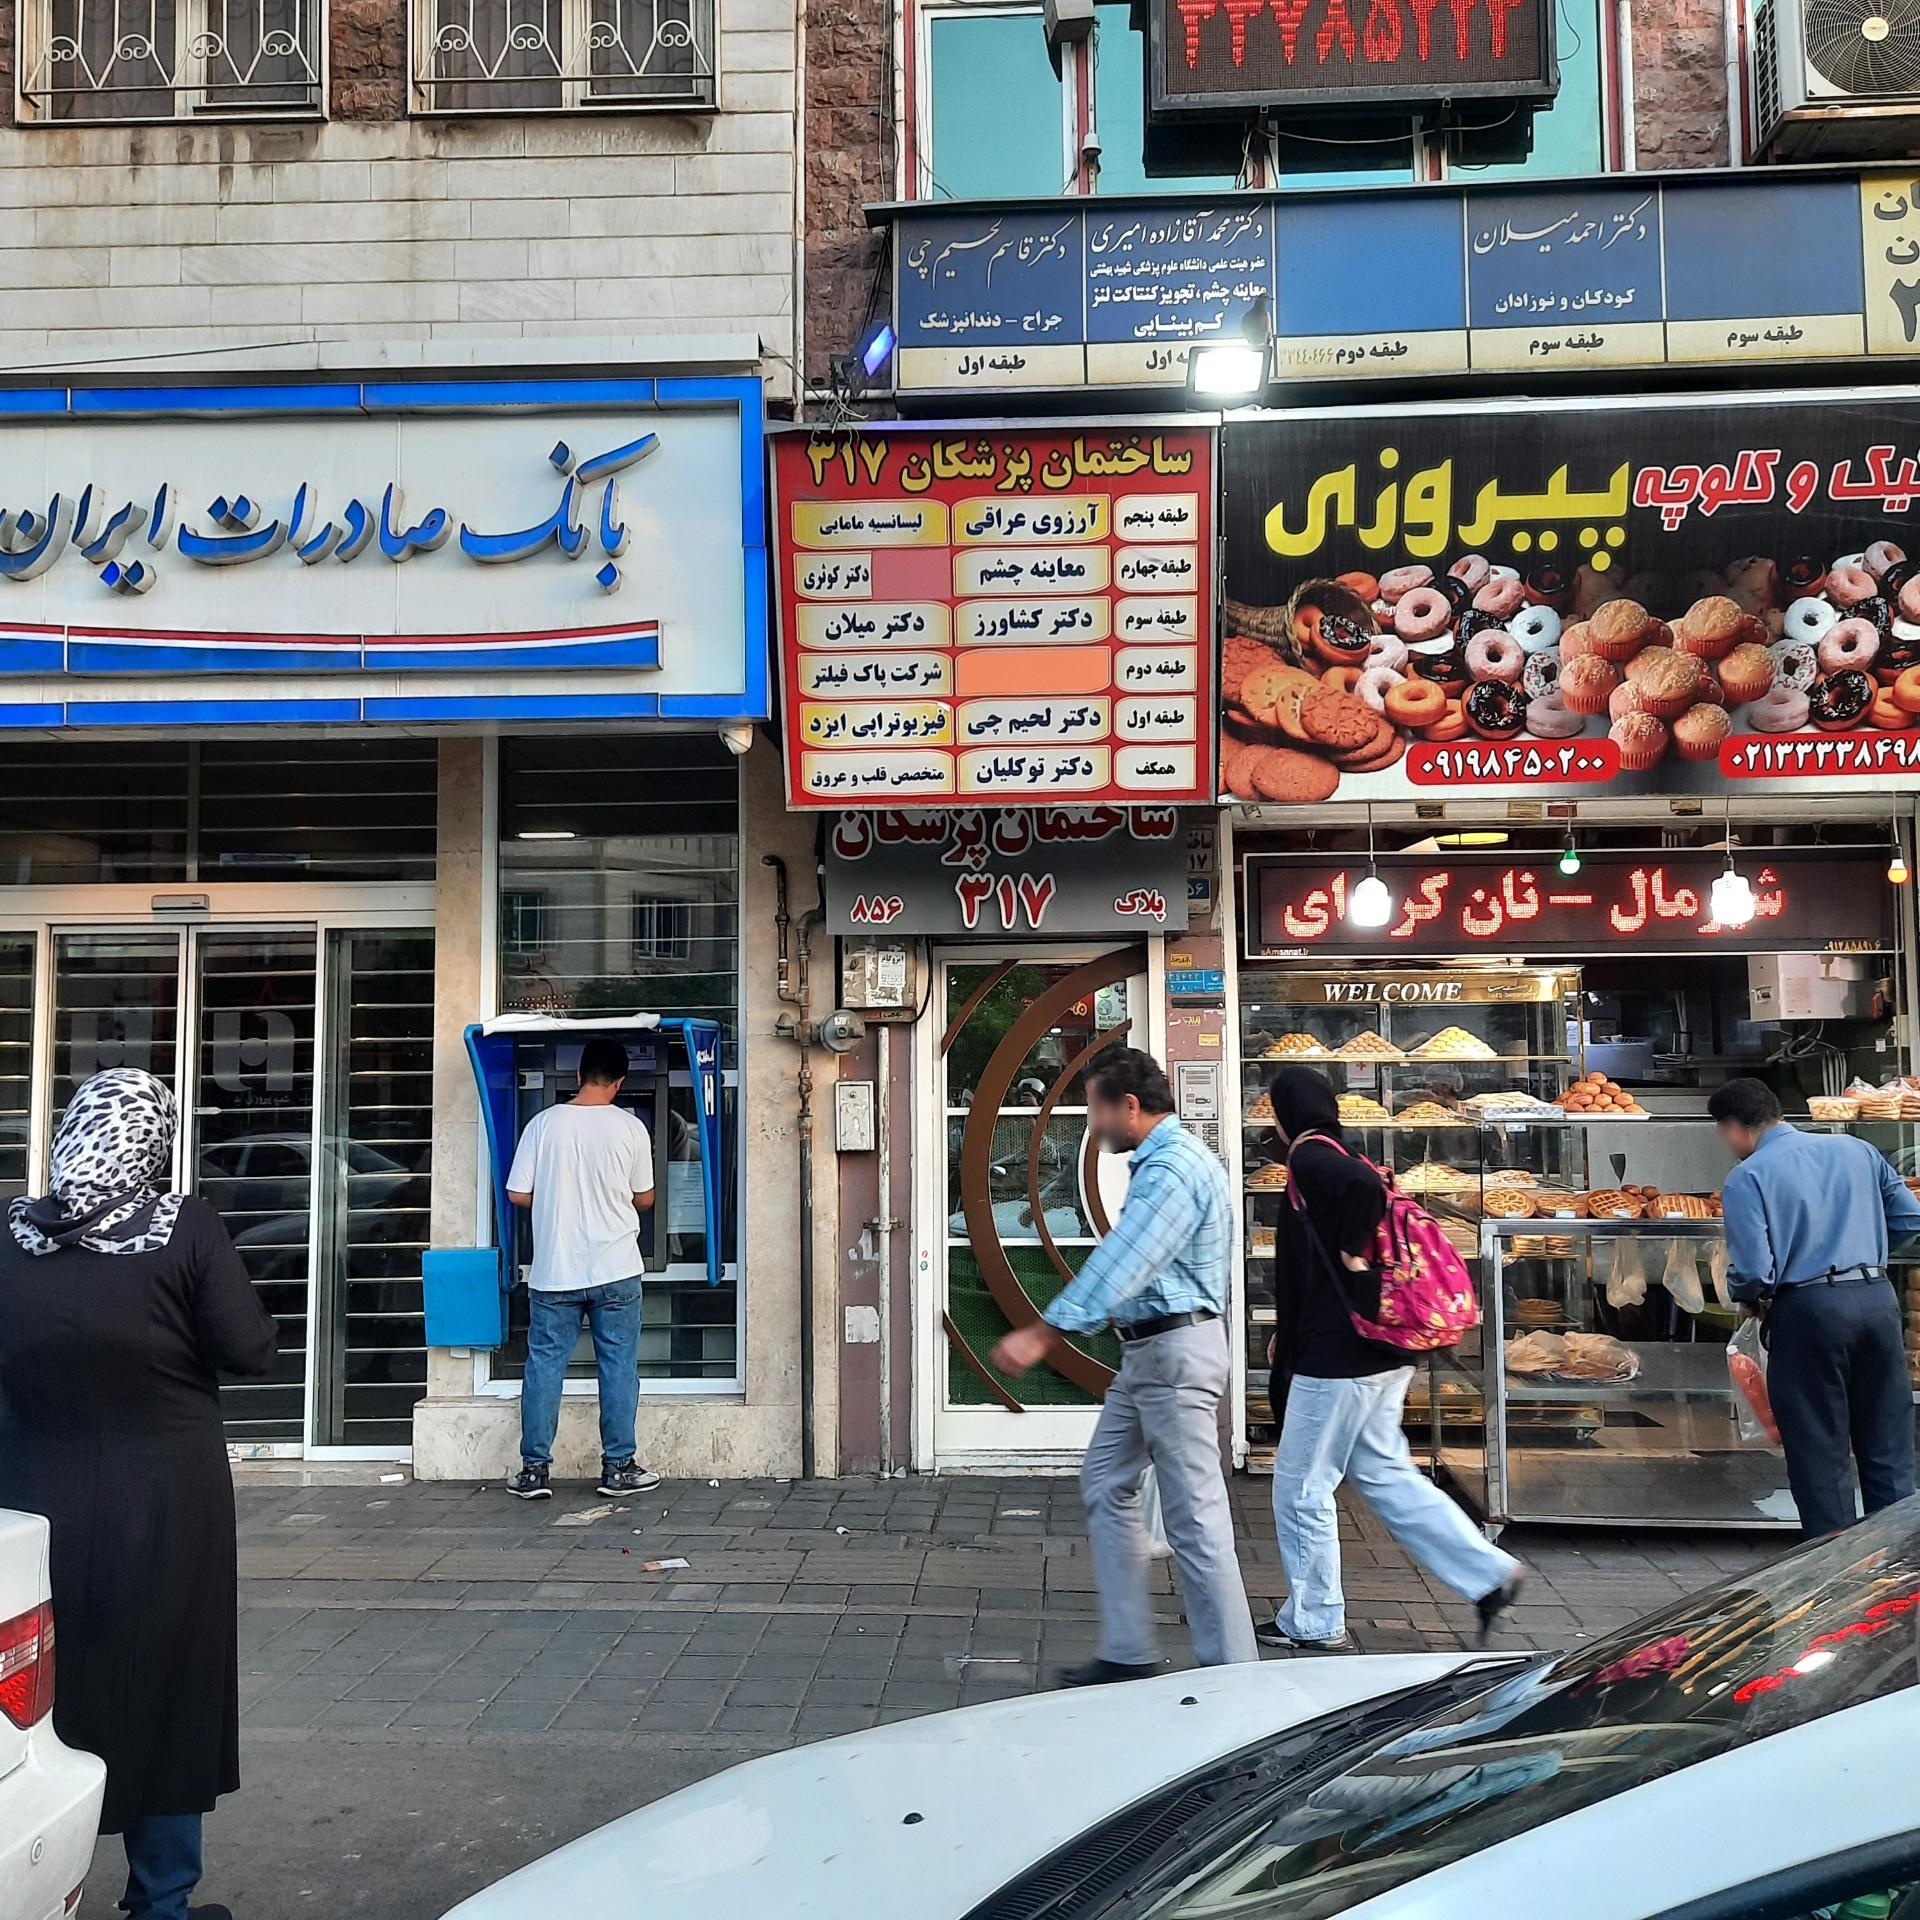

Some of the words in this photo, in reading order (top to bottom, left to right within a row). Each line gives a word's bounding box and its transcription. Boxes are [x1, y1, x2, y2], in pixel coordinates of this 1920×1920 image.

[1206, 217, 1231, 242] محمد
[1223, 201, 1264, 247] دکتر
[1473, 210, 1579, 254] میلان
[1565, 219, 1604, 246] احمد
[1601, 196, 1652, 250] دکتر
[1027, 216, 1076, 267] دکتر
[1091, 222, 1147, 253] امیری
[907, 239, 933, 280] چی
[987, 236, 1034, 290] قاسم
[1089, 263, 1114, 278] بهشتی
[1114, 260, 1132, 277] شهید
[1133, 260, 1160, 277] پزشکی
[1161, 259, 1178, 275] علوم
[1179, 257, 1207, 272] دانشگاه
[1208, 258, 1228, 273] علمی
[1250, 256, 1266, 272] عضو
[1091, 286, 1111, 308] لنز
[1112, 284, 1159, 302] کنتاکت
[1158, 283, 1196, 306] تجویز
[1232, 281, 1267, 301] معاینه
[1495, 290, 1556, 314] نوزادان
[1559, 295, 1569, 311] و
[1571, 288, 1636, 310] کودکان
[919, 310, 1002, 334] دندانپزشک
[1022, 310, 1063, 331] جراح
[1133, 313, 1193, 338] بینایی
[1194, 311, 1225, 335] کم
[1529, 336, 1561, 355] سوم
[1565, 332, 1604, 352] طبقه
[1726, 331, 1759, 348] سوم
[1763, 324, 1804, 345] طبقه
[1145, 349, 1172, 370] اول
[1335, 346, 1365, 365] دوم
[1369, 341, 1409, 361] طبقه
[957, 355, 985, 375] اول
[988, 354, 1026, 374] طبقه
[805, 437, 890, 487] ۳۱۷
[900, 438, 1033, 493] پزشکان
[1041, 435, 1193, 489] ساختمان
[1633, 449, 1782, 532] کلوچه
[1785, 459, 1820, 515] و
[1828, 445, 1920, 513] یک
[459, 431, 661, 595] بانک
[965, 507, 1027, 536] عراقی
[1032, 503, 1099, 536] آرزوی
[1123, 512, 1155, 529] پنجم
[1157, 508, 1189, 524] طبقه
[1264, 446, 1631, 573] پیروزی
[177, 481, 453, 566] صادرات
[819, 514, 868, 536] مامایی
[870, 511, 923, 534] لیسانسیه
[0, 481, 176, 595] ایران
[803, 564, 840, 592] کوثری
[843, 563, 869, 588] دکتر
[979, 561, 1023, 586] چشم
[1029, 556, 1086, 579] معاینه
[1121, 560, 1159, 579] چهارم
[1160, 559, 1191, 576] طبقه
[825, 612, 876, 640] میلان
[882, 612, 925, 640] دکتر
[975, 607, 1043, 638] کشاورز
[1049, 607, 1093, 635] دکتر
[1125, 613, 1153, 630] سوم
[1156, 608, 1187, 626] طبقه
[811, 662, 848, 689] فیلتر
[853, 662, 887, 689] پاک
[890, 662, 942, 687] شرکت
[1125, 663, 1152, 679] دوم
[1155, 659, 1187, 677] طبقه
[810, 712, 847, 738] ایزد
[853, 708, 947, 738] فیزیوتراپی
[967, 713, 1001, 738] چی
[1009, 707, 1052, 733] لحیم
[1060, 706, 1101, 735] دکتر
[1126, 710, 1151, 729] اول
[1154, 710, 1185, 728] طبقه
[1421, 747, 1605, 779] ۰۹۱۹۸۴۵۰۲۰۰
[1731, 738, 1920, 771] ۰۲۱۳۳۳۳۸۴۹۸
[811, 768, 847, 788] عروق
[849, 774, 858, 787] و
[860, 766, 888, 783] قلب
[890, 768, 945, 787] متخصص
[976, 757, 1043, 787] توکلیان
[1051, 756, 1093, 784] دکتر
[1135, 761, 1176, 778] همکف
[1188, 853, 1208, 869] ۱۷
[850, 894, 904, 924] ۸۵۶
[955, 872, 1056, 930] ۳۱۷
[1114, 888, 1168, 922] پلاک
[1463, 870, 1539, 936] نان
[1323, 982, 1462, 1002] WELCOME
